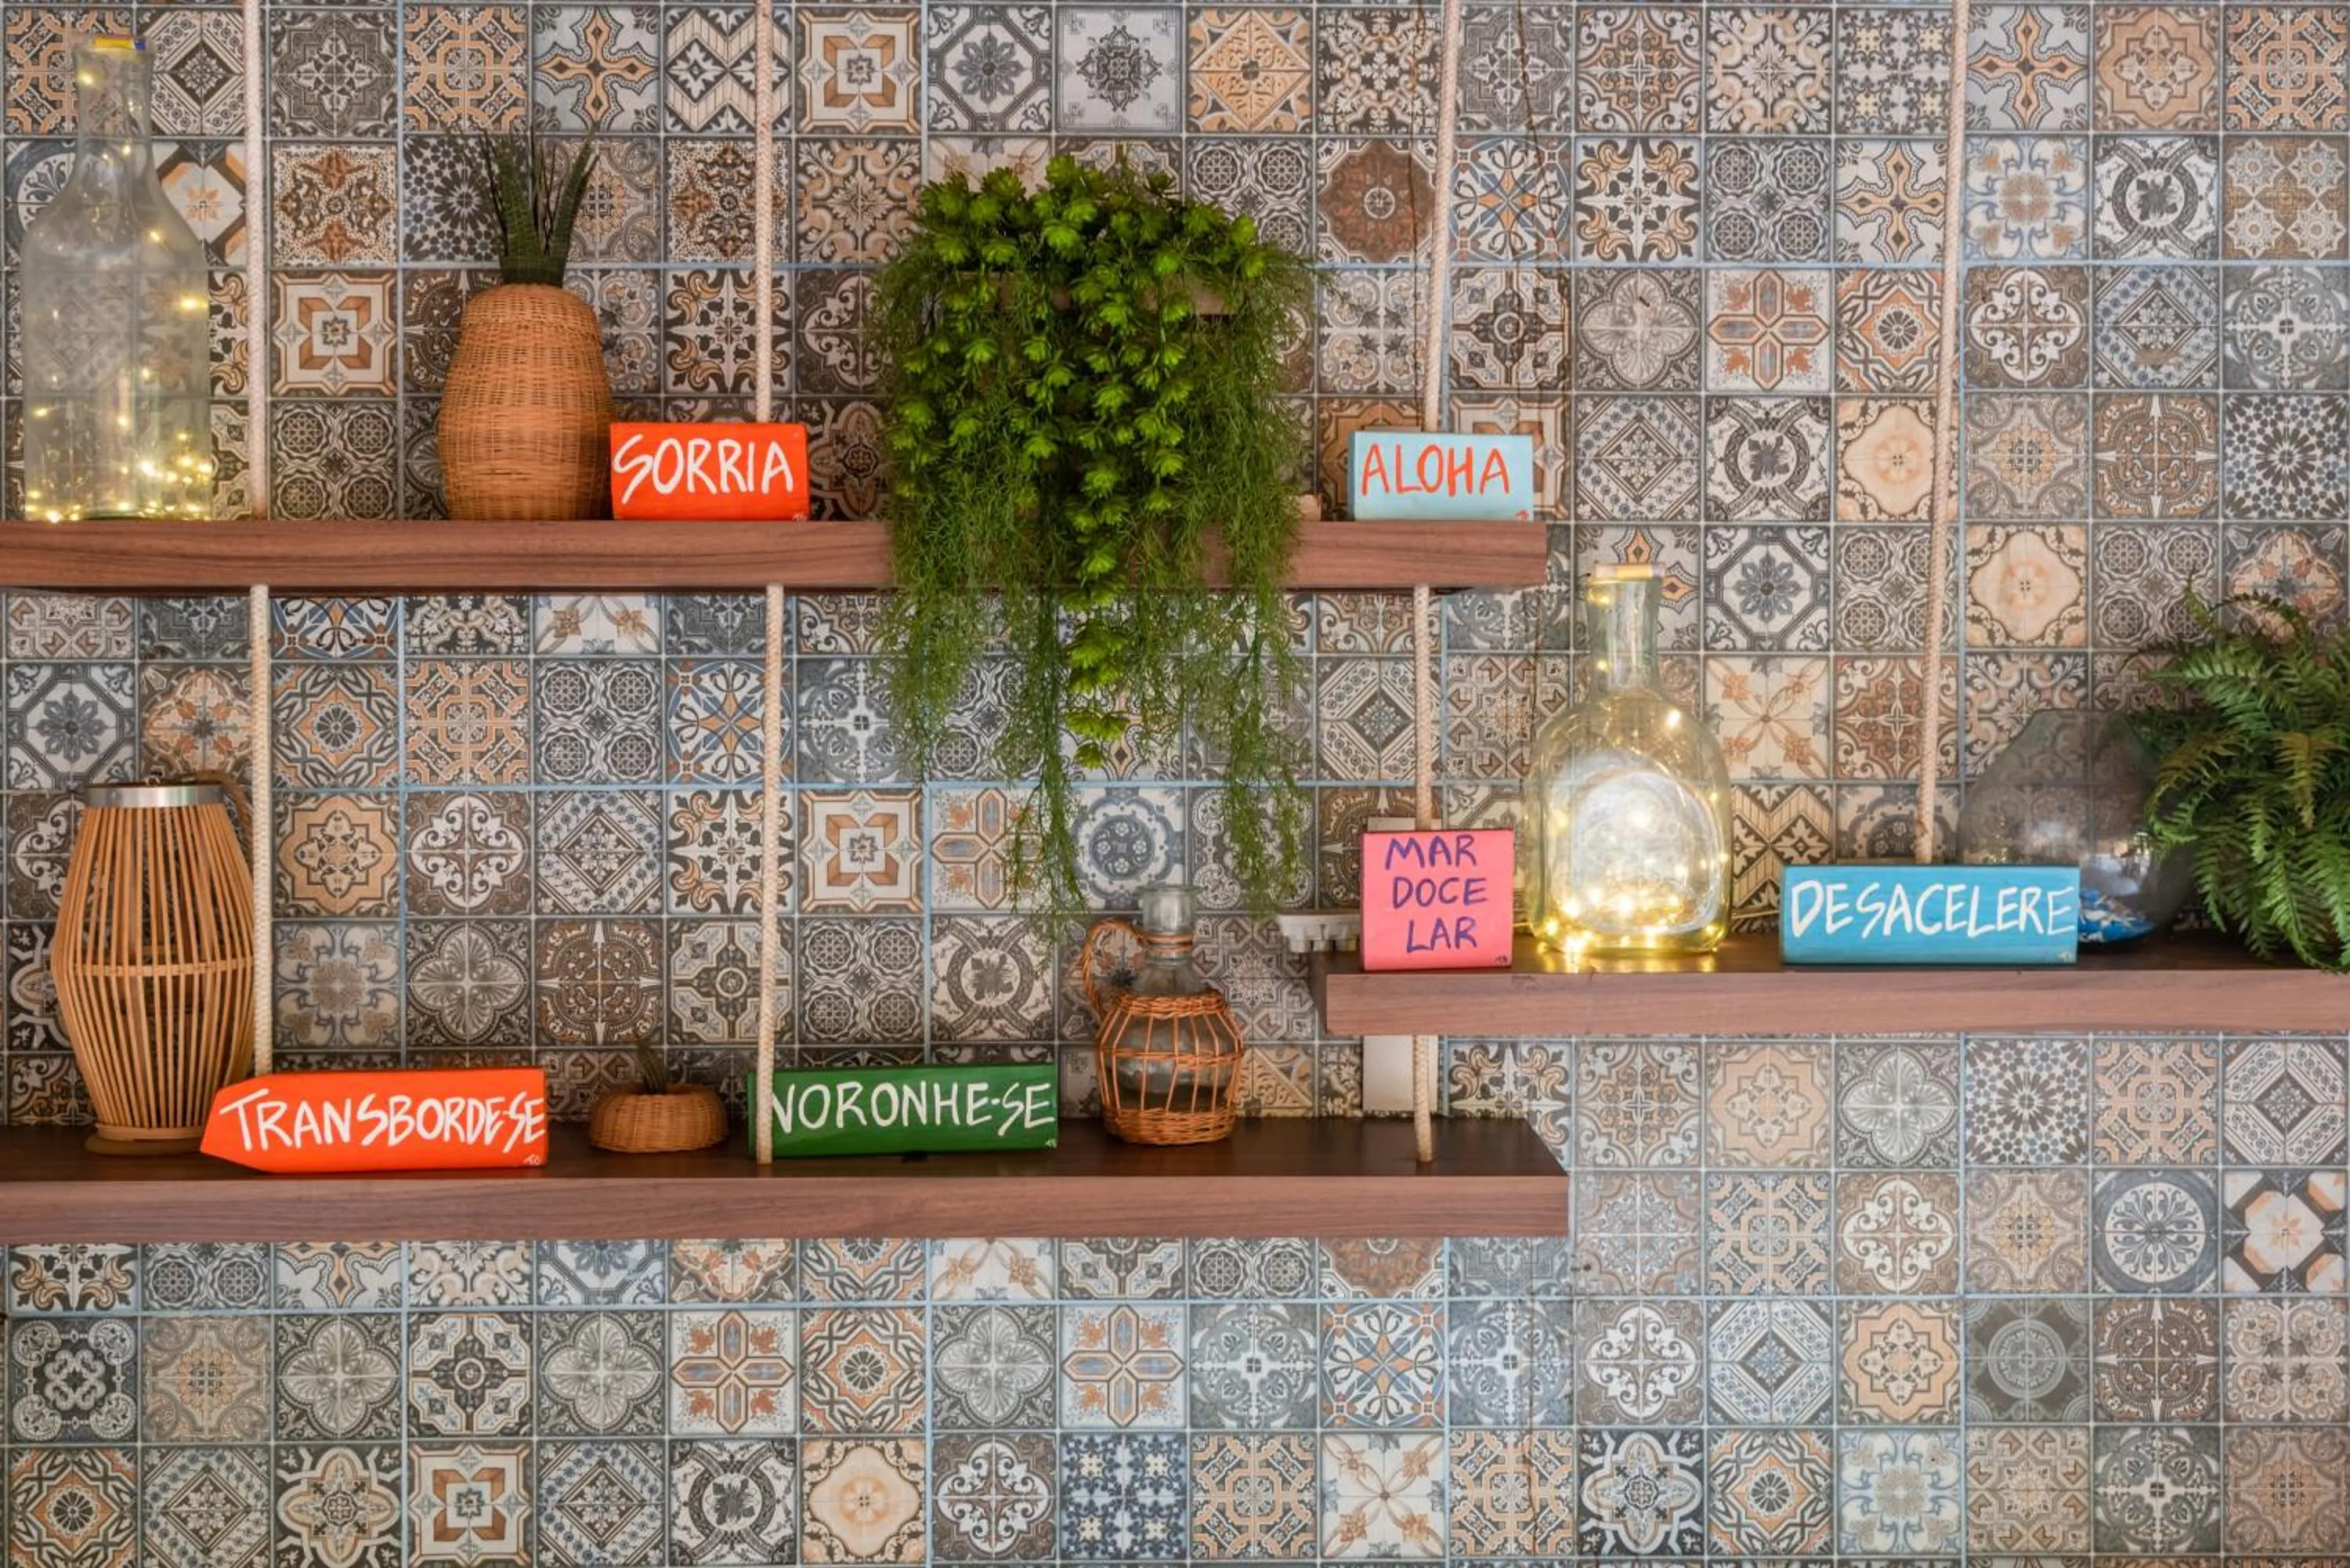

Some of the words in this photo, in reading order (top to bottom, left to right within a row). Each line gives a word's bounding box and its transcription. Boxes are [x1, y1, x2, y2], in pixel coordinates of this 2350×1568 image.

[613, 433, 794, 504] SORRIA
[1361, 443, 1510, 497] ALOHA
[1385, 834, 1477, 870] MAR
[1392, 876, 1488, 909] DOCE
[1791, 880, 2076, 939] DESACELERE
[1406, 916, 1477, 953] LAR
